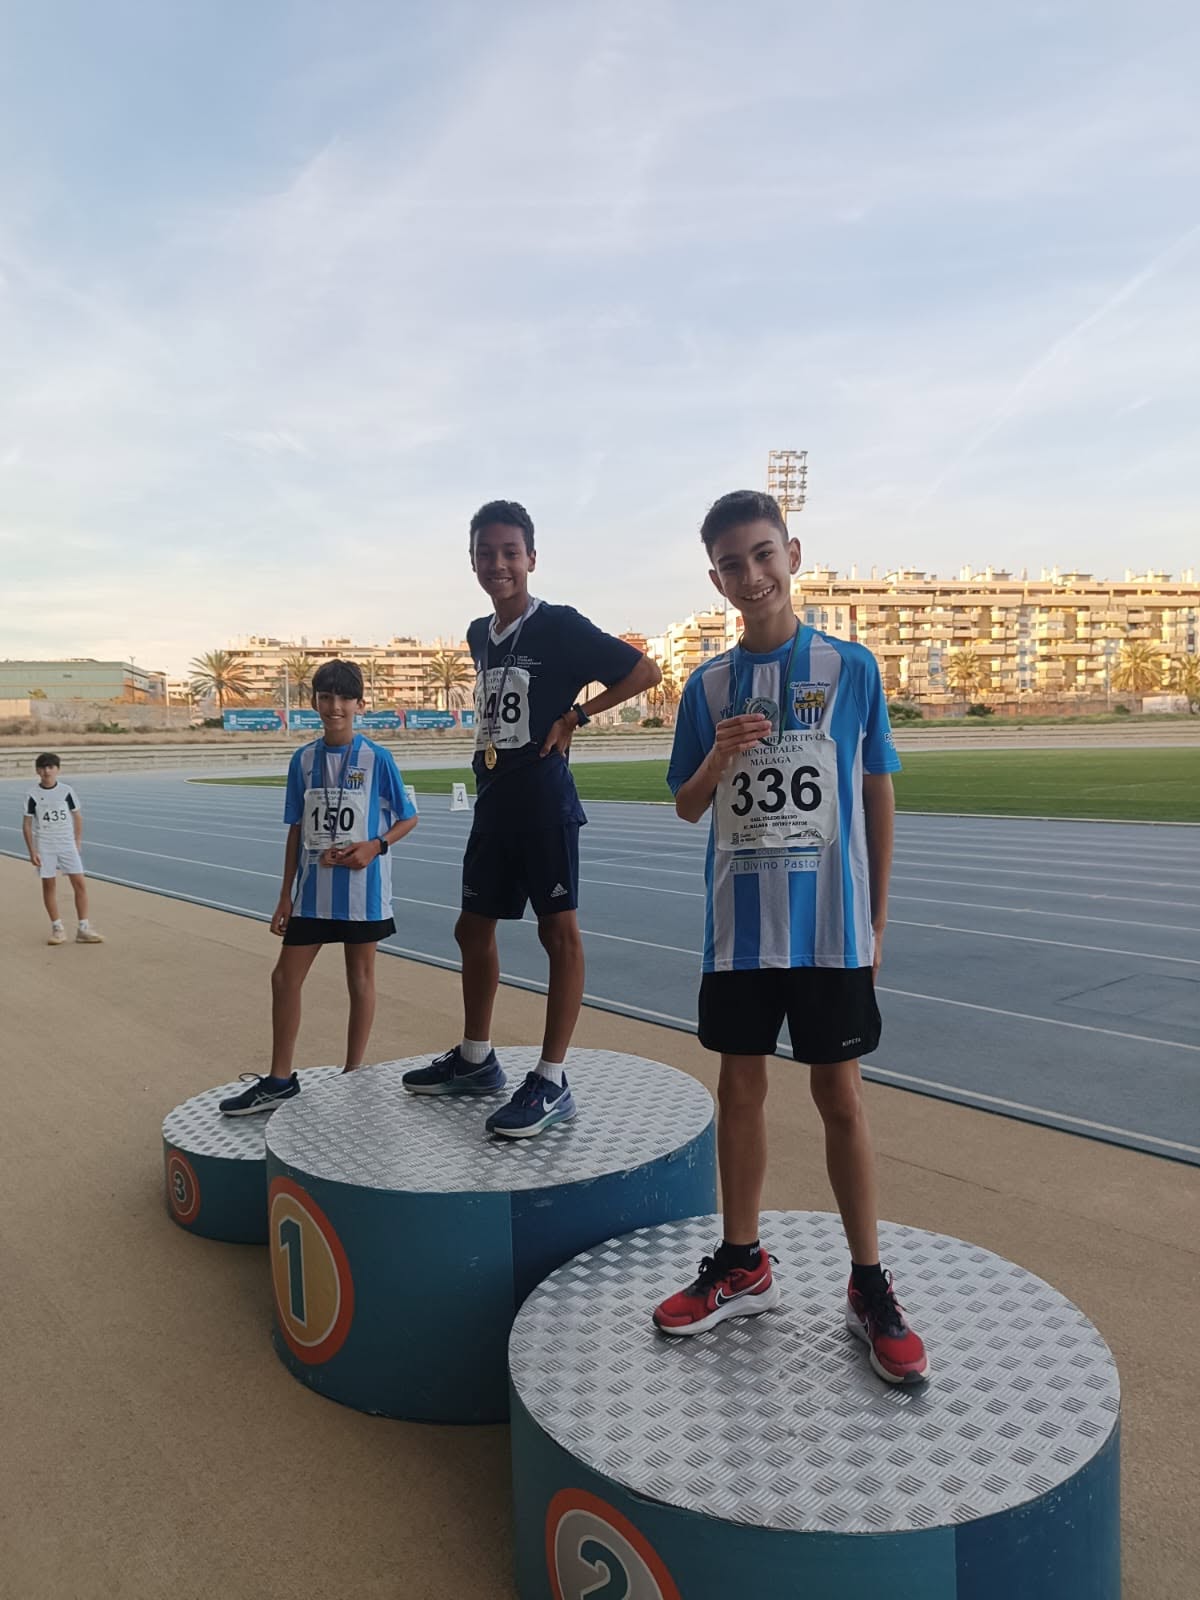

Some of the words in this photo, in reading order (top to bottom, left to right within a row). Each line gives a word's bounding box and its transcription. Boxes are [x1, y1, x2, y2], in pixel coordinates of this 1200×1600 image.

[742, 744, 804, 758] MUNICIPALES
[750, 755, 792, 767] MÁLAGA
[457, 791, 464, 803] 4
[730, 765, 822, 817] 336
[42, 810, 67, 822] 435
[311, 807, 355, 832] 150
[729, 862, 738, 872] El
[743, 861, 778, 871] Divino
[784, 858, 821, 869] Pastor
[174, 1170, 187, 1203] 3
[279, 1215, 308, 1328] 1
[578, 1534, 632, 1600] 2
